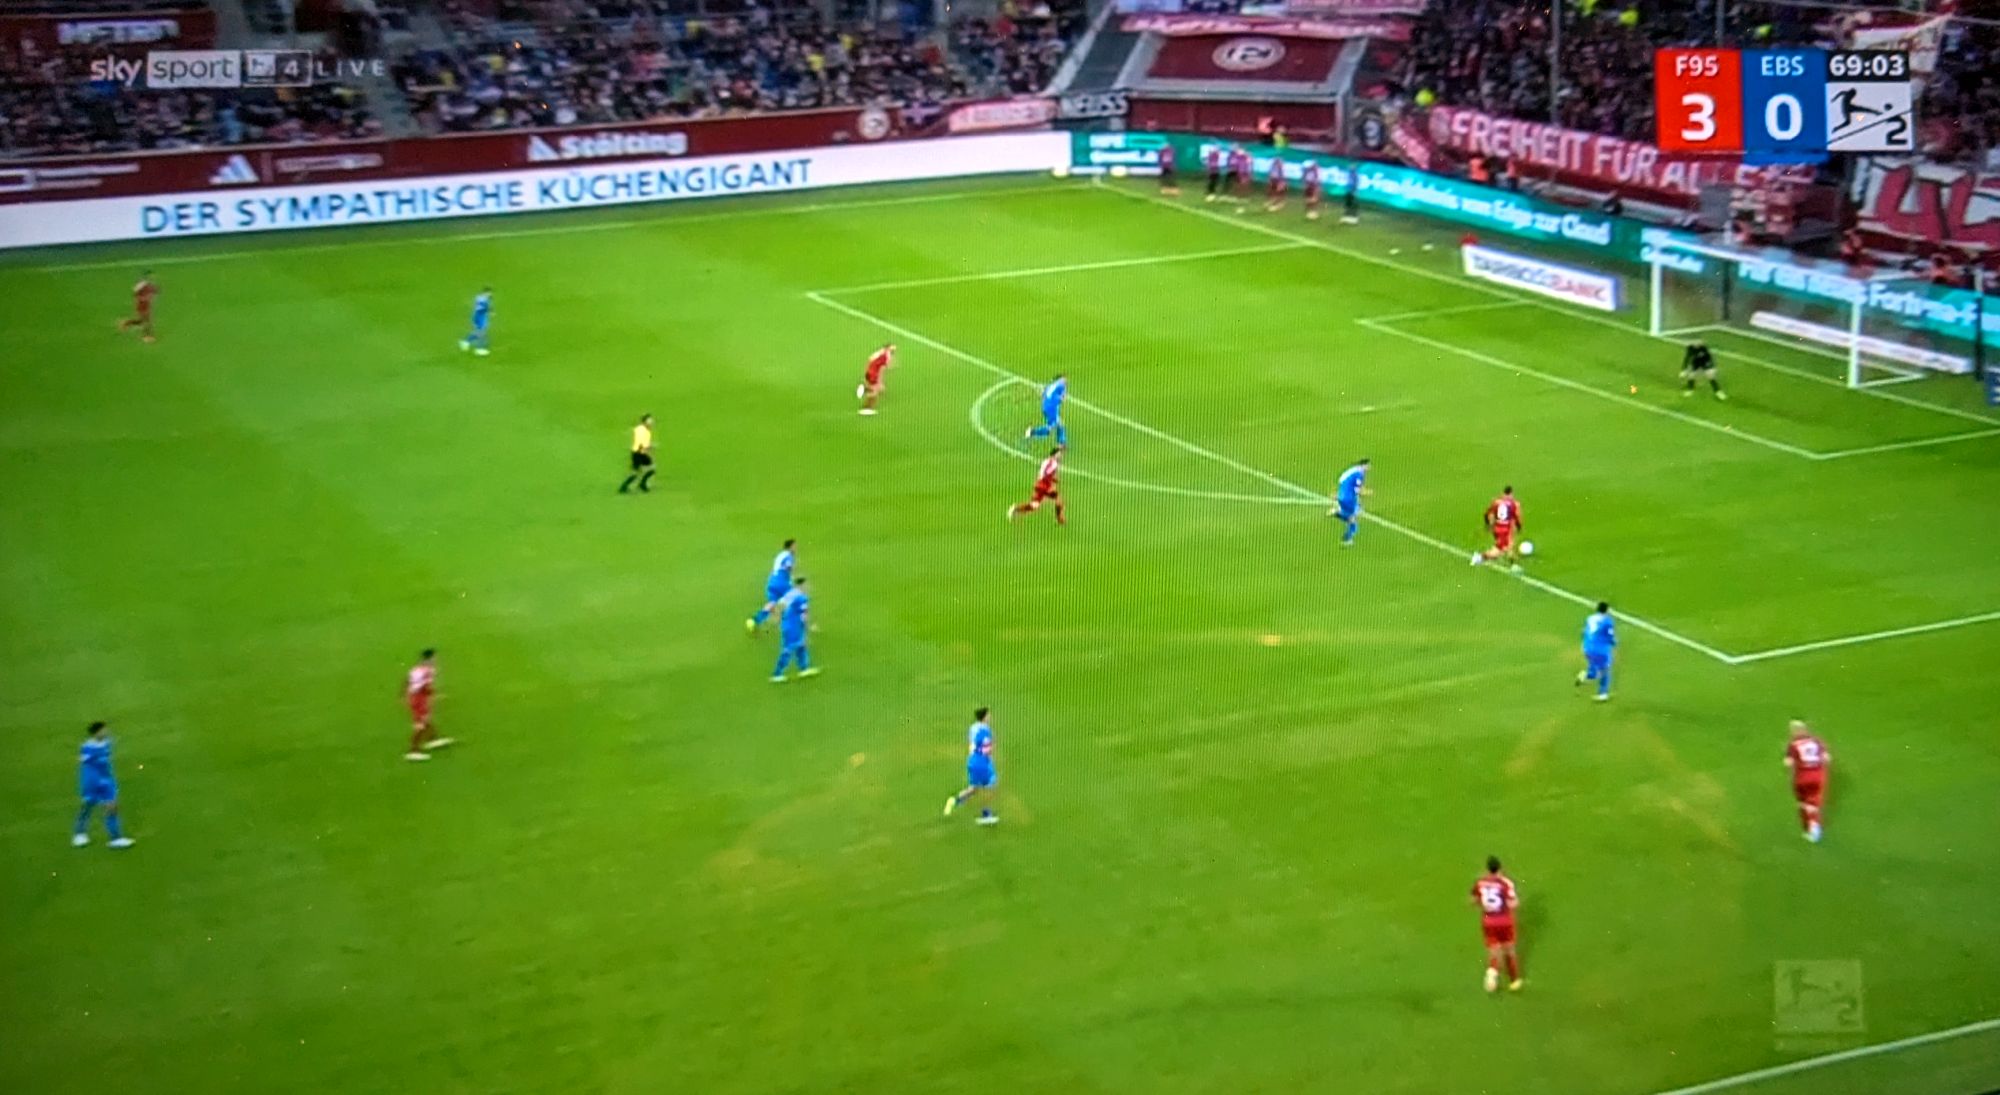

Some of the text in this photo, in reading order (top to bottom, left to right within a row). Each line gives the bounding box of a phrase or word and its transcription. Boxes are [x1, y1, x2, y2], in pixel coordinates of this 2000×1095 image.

[1452, 110, 1590, 172] FREIHEIT
[1592, 137, 1659, 187] FÜR
[141, 157, 813, 233] DER SYMPATHISCHE KÜCHENGIGANT
